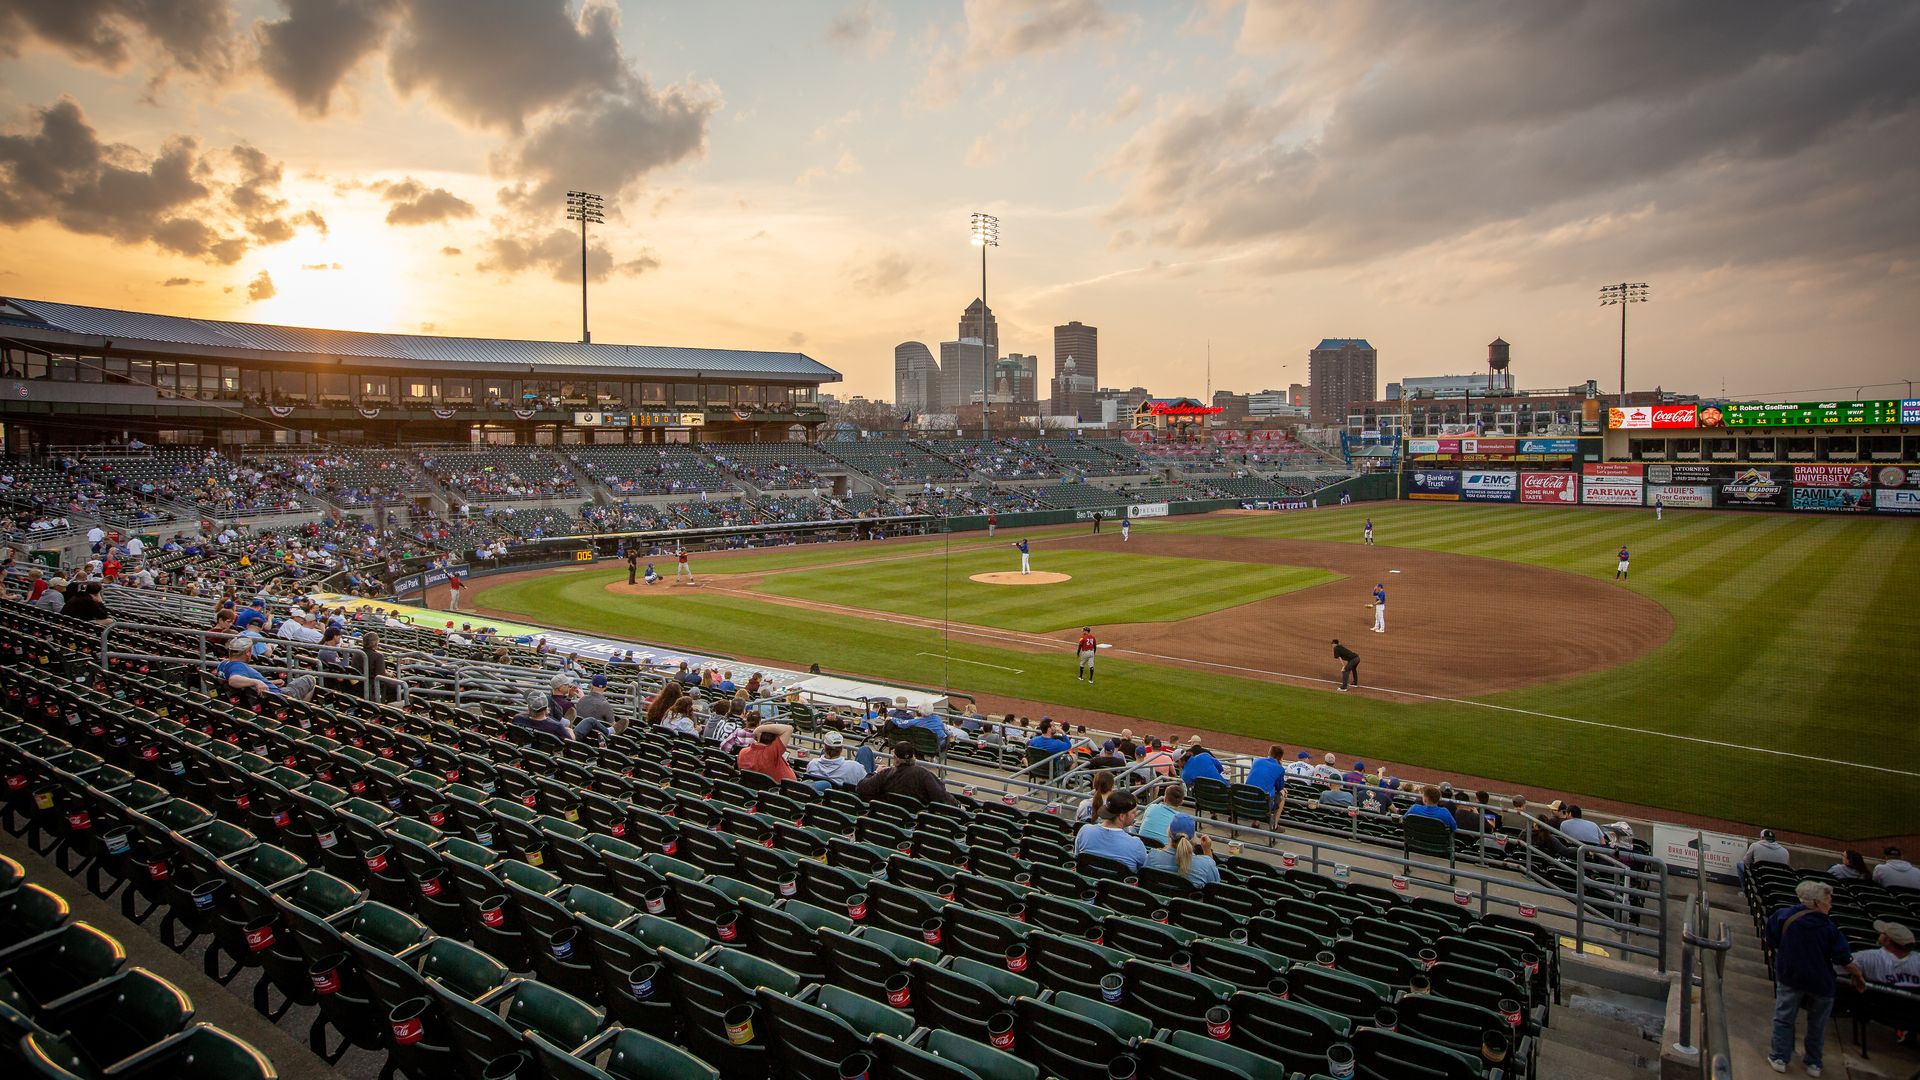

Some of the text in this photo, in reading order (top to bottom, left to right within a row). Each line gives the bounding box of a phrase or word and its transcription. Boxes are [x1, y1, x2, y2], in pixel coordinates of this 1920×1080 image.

[1653, 409, 1696, 423] Coca-Cola
[1483, 475, 1510, 484] EMC
[1524, 475, 1565, 488] Coca-Cola
[1794, 489, 1841, 500] FAMILY
[408, 578, 419, 588] Park
